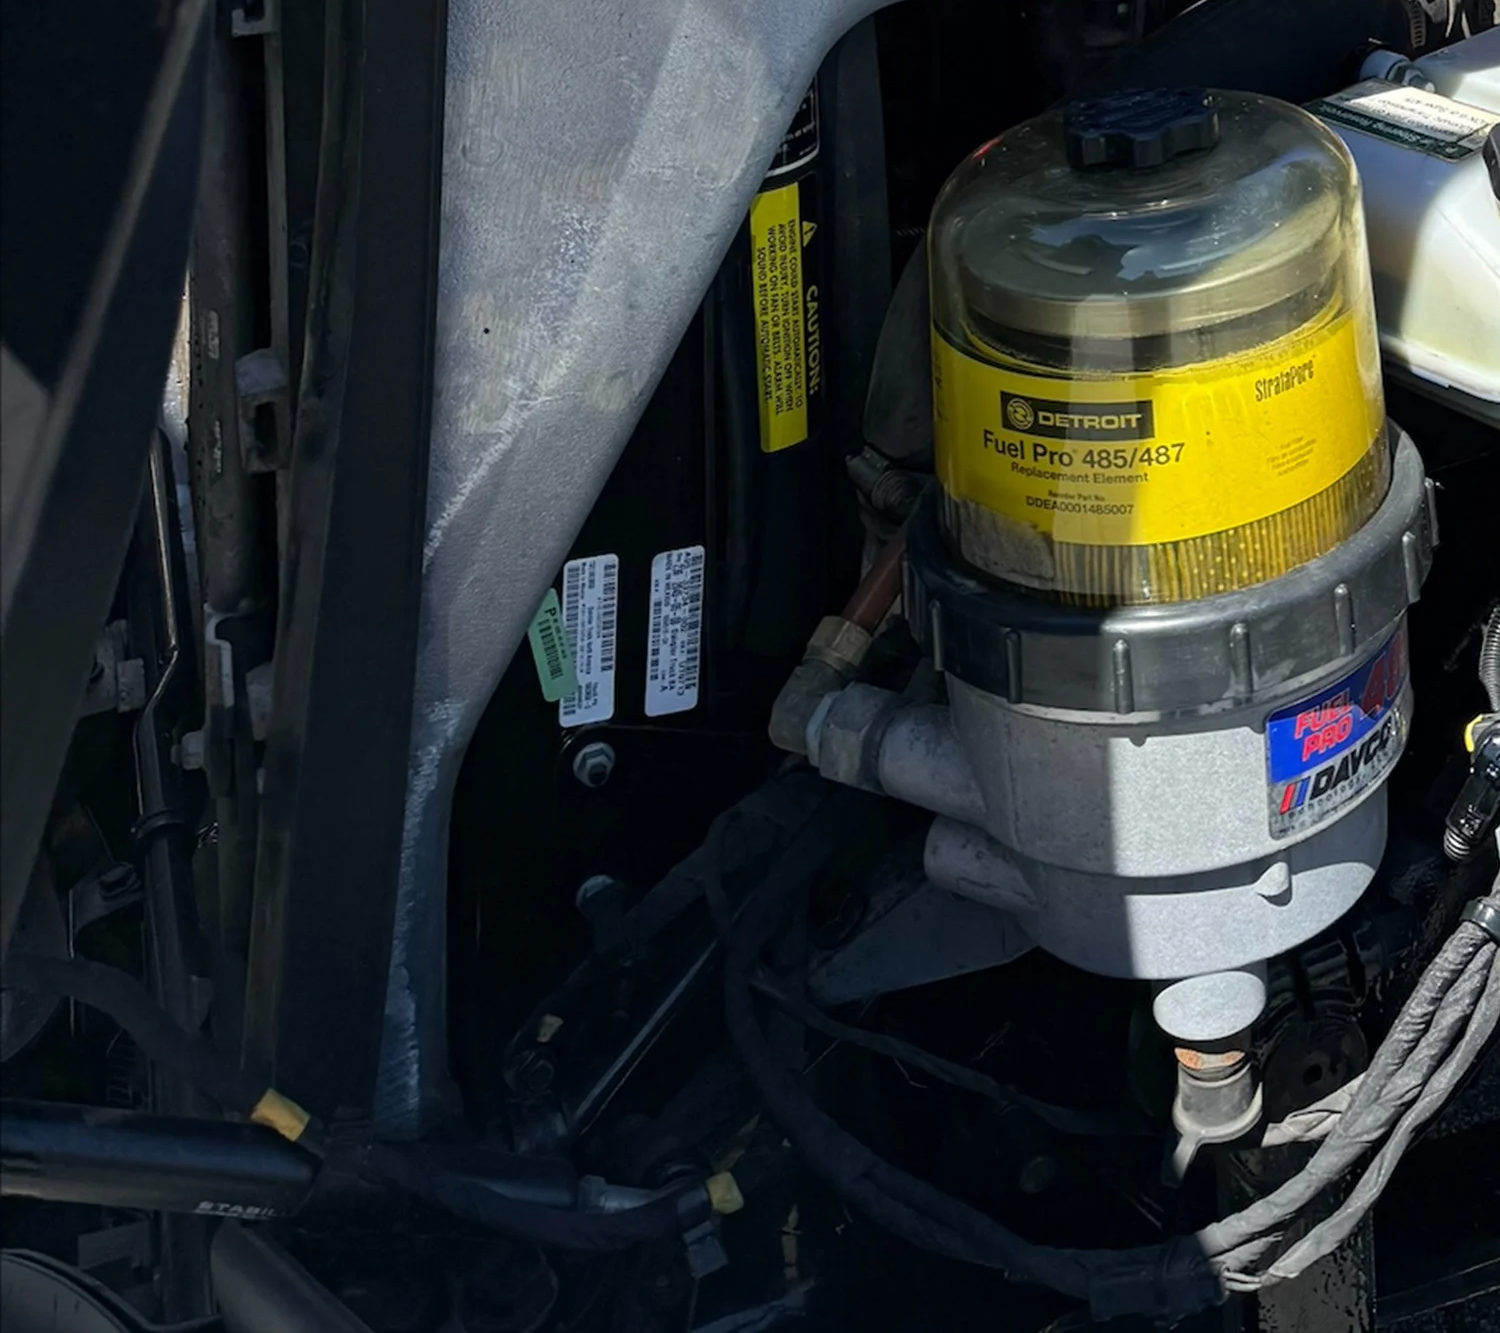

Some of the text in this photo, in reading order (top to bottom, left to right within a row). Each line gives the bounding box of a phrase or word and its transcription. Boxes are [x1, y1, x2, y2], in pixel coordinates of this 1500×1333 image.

[767, 226, 777, 273] WORKING
[787, 219, 797, 254] ENGINE
[756, 247, 766, 281] SOUND
[758, 284, 768, 317] BEFORE
[769, 276, 778, 291] ON
[778, 224, 786, 252] AVOID
[782, 319, 790, 361] IGNITION
[770, 294, 778, 312] FAN
[771, 315, 779, 328] OR
[806, 285, 821, 394] CAUTION:
[773, 361, 782, 392] ALARM
[1255, 358, 1316, 403] StrataPore
[1038, 411, 1142, 430] DETROIT
[983, 428, 1024, 460] Fuel
[1082, 443, 1185, 469] 485/487
[1011, 461, 1148, 484] Replacement Element
[1295, 688, 1351, 739] FUEL
[1302, 715, 1353, 762] PRO
[1310, 716, 1392, 800] DAVCO
